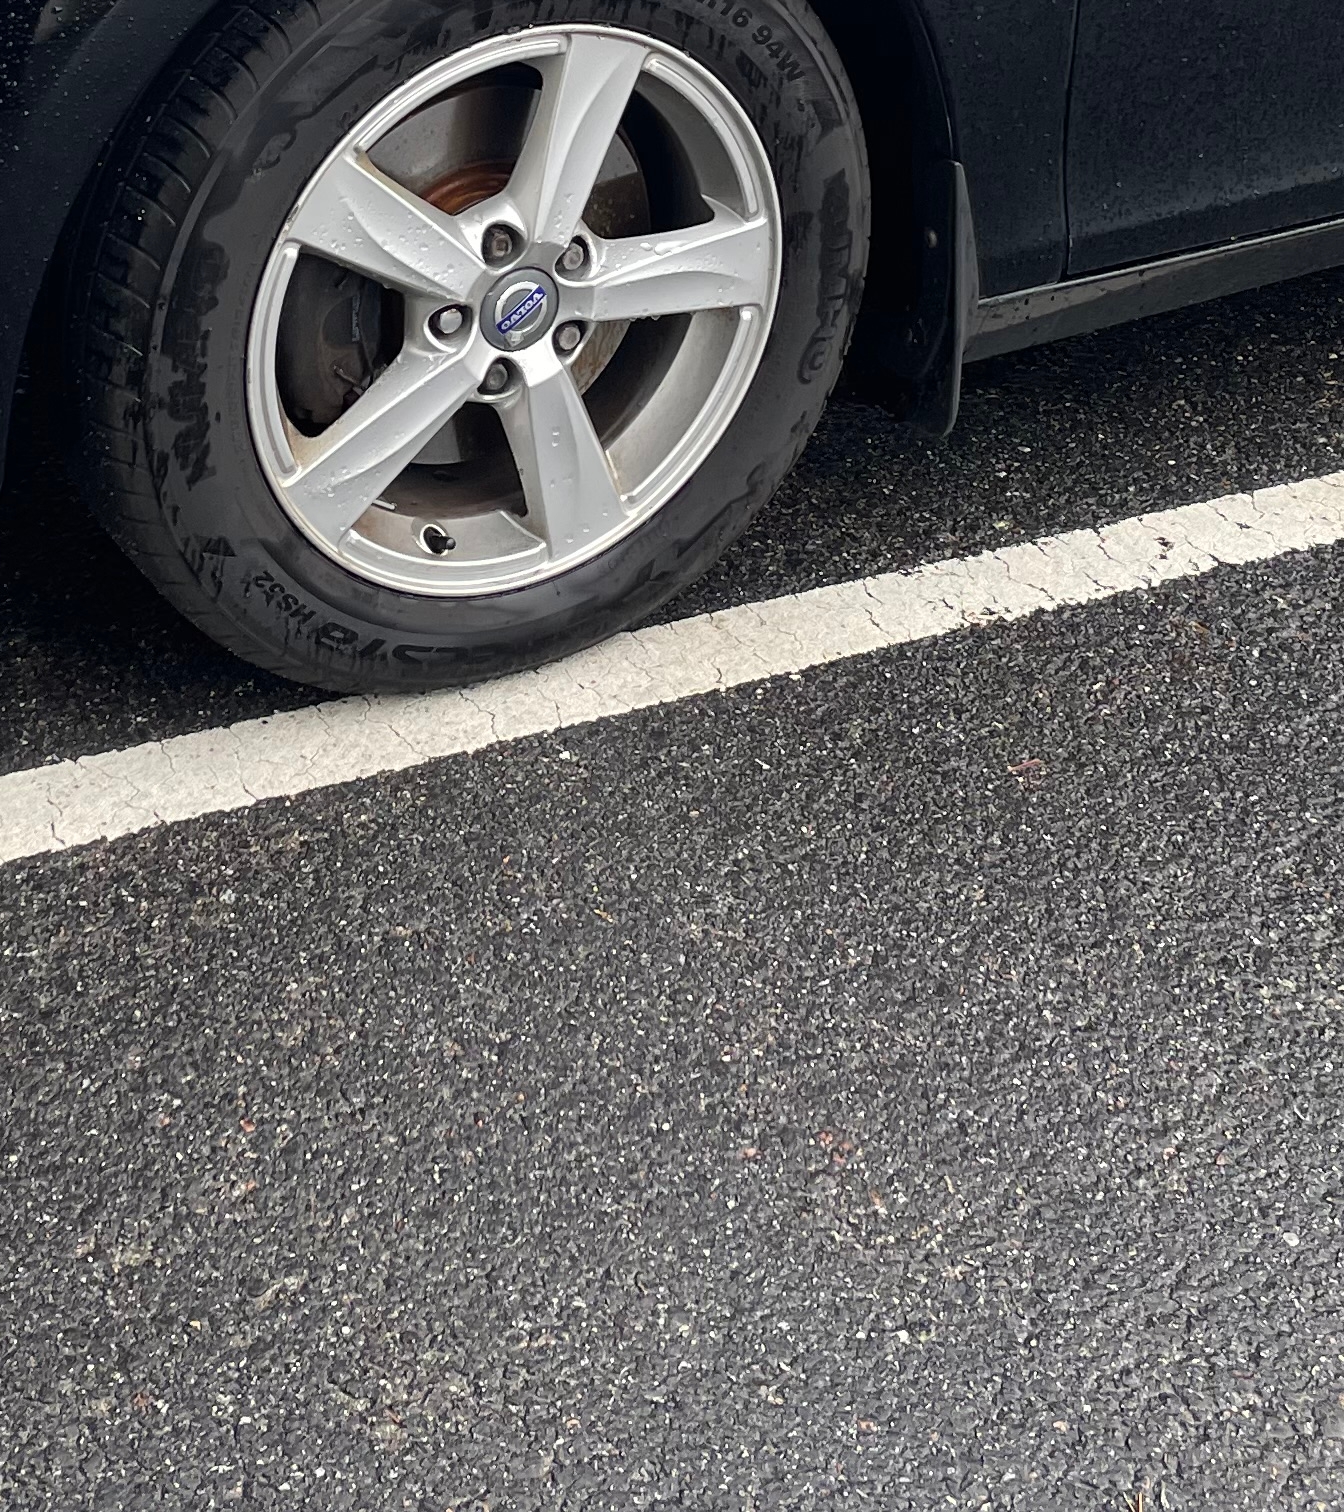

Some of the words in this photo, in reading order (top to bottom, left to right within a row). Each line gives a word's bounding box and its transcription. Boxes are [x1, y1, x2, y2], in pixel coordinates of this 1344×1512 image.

[751, 24, 805, 83] 94W
[500, 292, 544, 330] VOLVO
[252, 569, 317, 624] HS52
